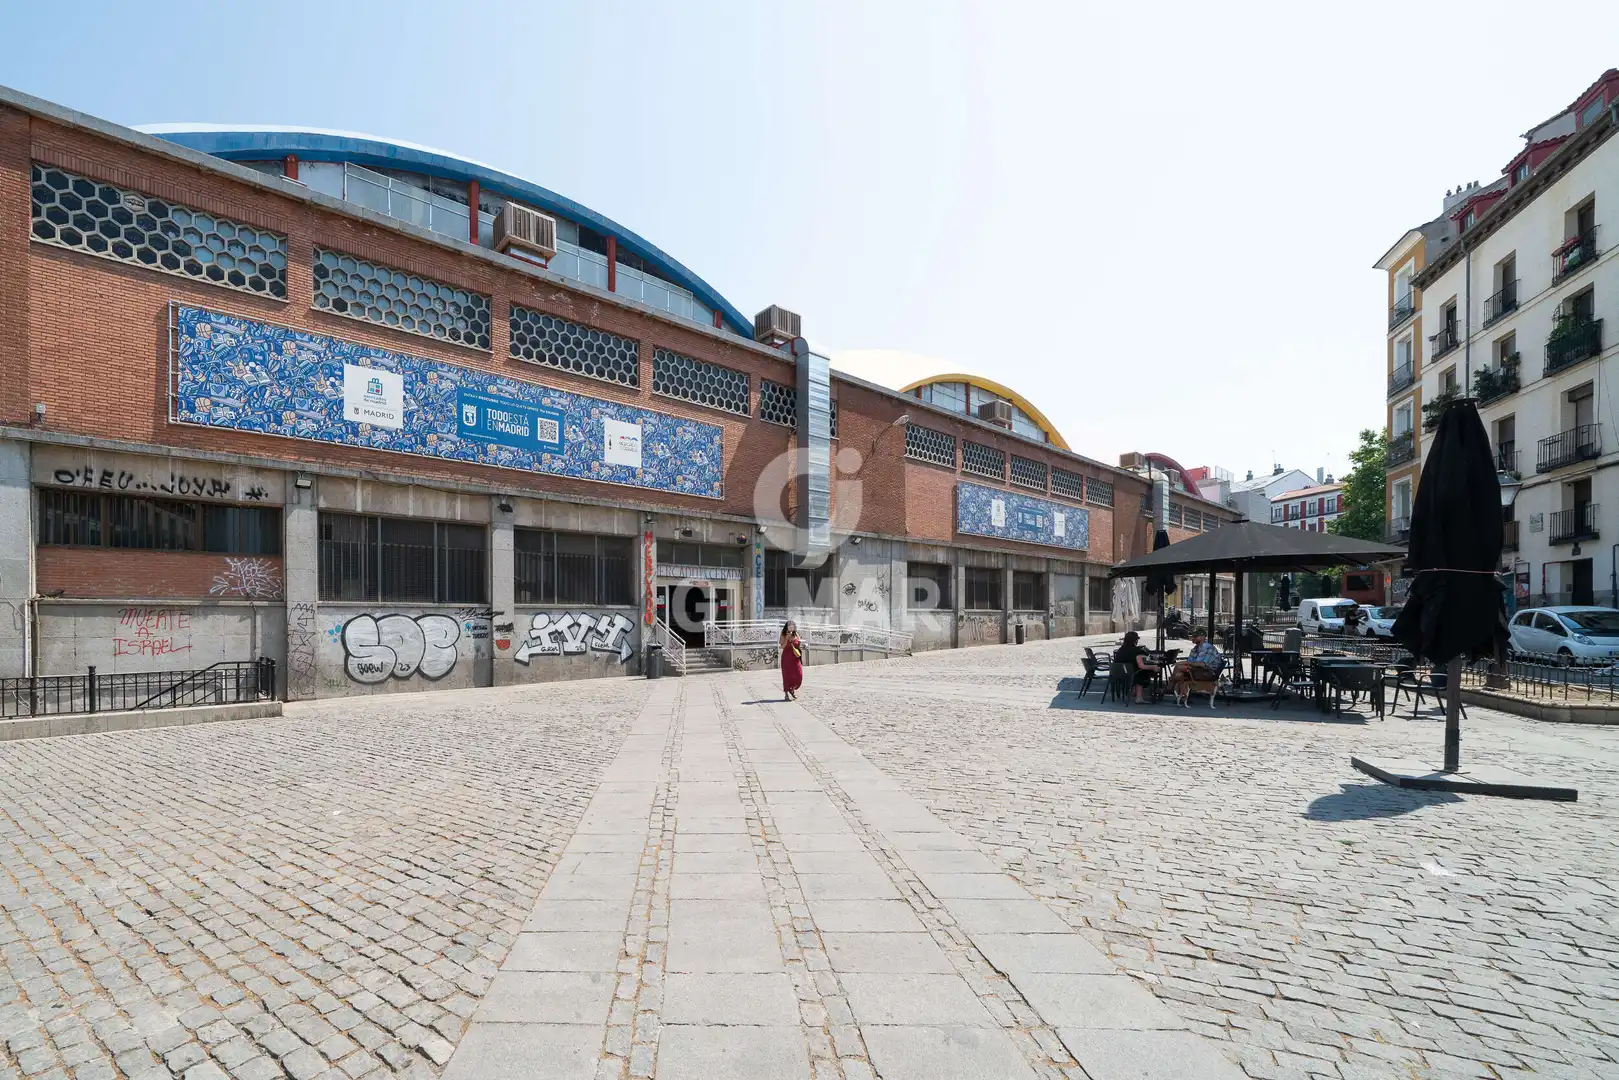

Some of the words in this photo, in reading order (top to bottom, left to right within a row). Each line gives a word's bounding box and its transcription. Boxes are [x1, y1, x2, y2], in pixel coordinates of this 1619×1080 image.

[363, 409, 395, 420] MADRID
[118, 607, 193, 631] MUERTE
[134, 626, 154, 640] A
[112, 636, 193, 657] ISRAEL
